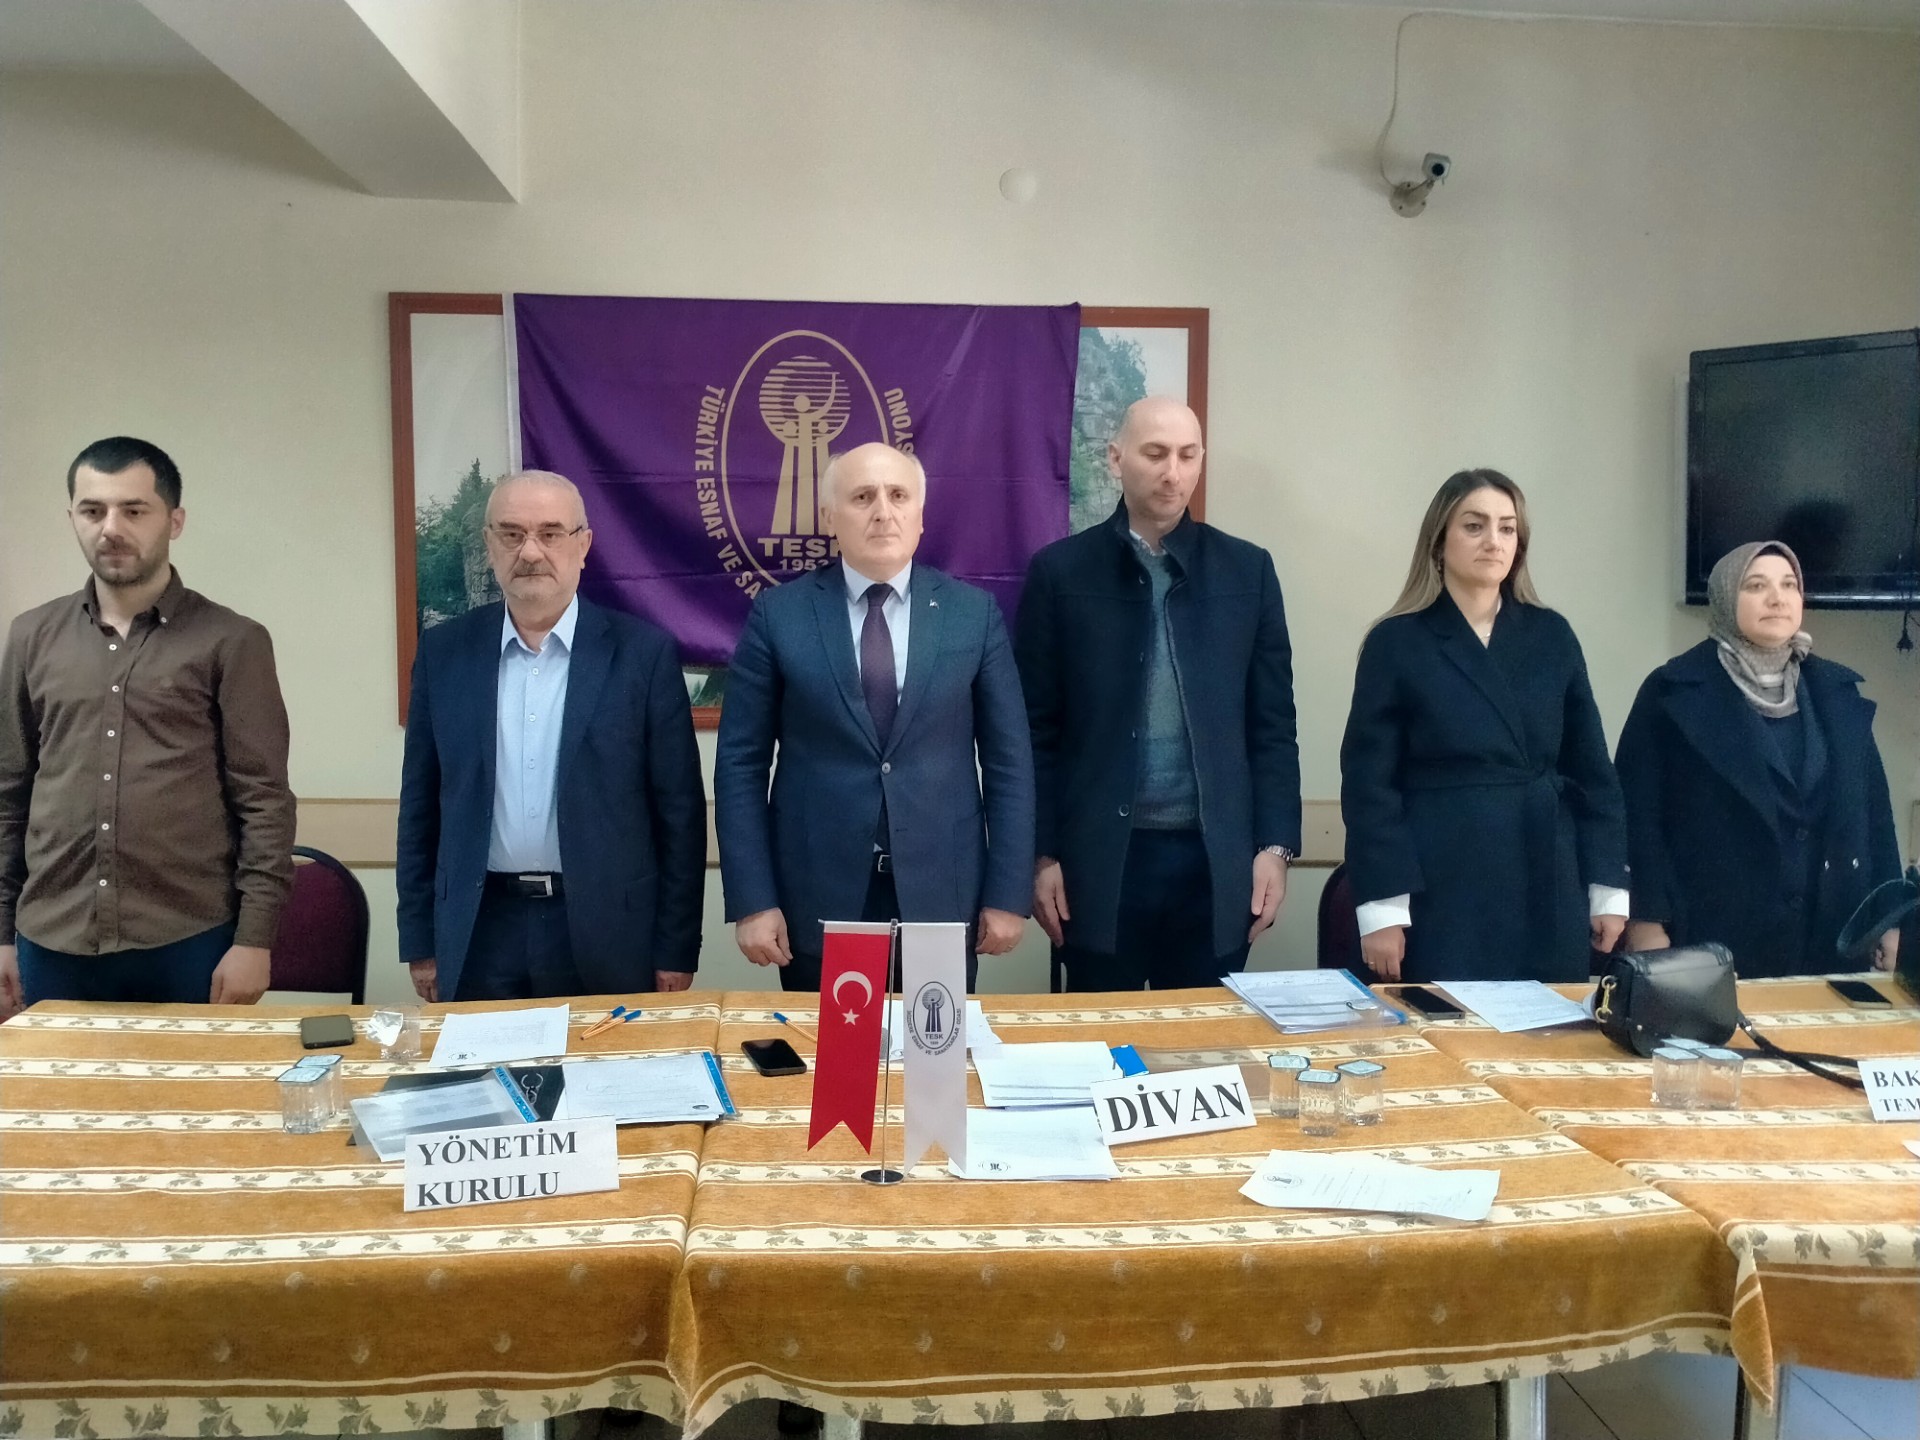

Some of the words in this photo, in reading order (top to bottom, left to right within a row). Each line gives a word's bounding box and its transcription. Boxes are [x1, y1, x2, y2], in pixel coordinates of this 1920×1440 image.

[695, 385, 726, 471] TÜRKİYE
[696, 477, 728, 540] ESNAF
[717, 543, 742, 572] VE
[735, 571, 764, 599] SA
[1872, 1070, 1920, 1087] BAK
[1103, 1082, 1246, 1133] DİVAN
[1879, 1098, 1920, 1112] TEM
[418, 1128, 578, 1166] YÖNETİM
[417, 1171, 561, 1207] KURULU
